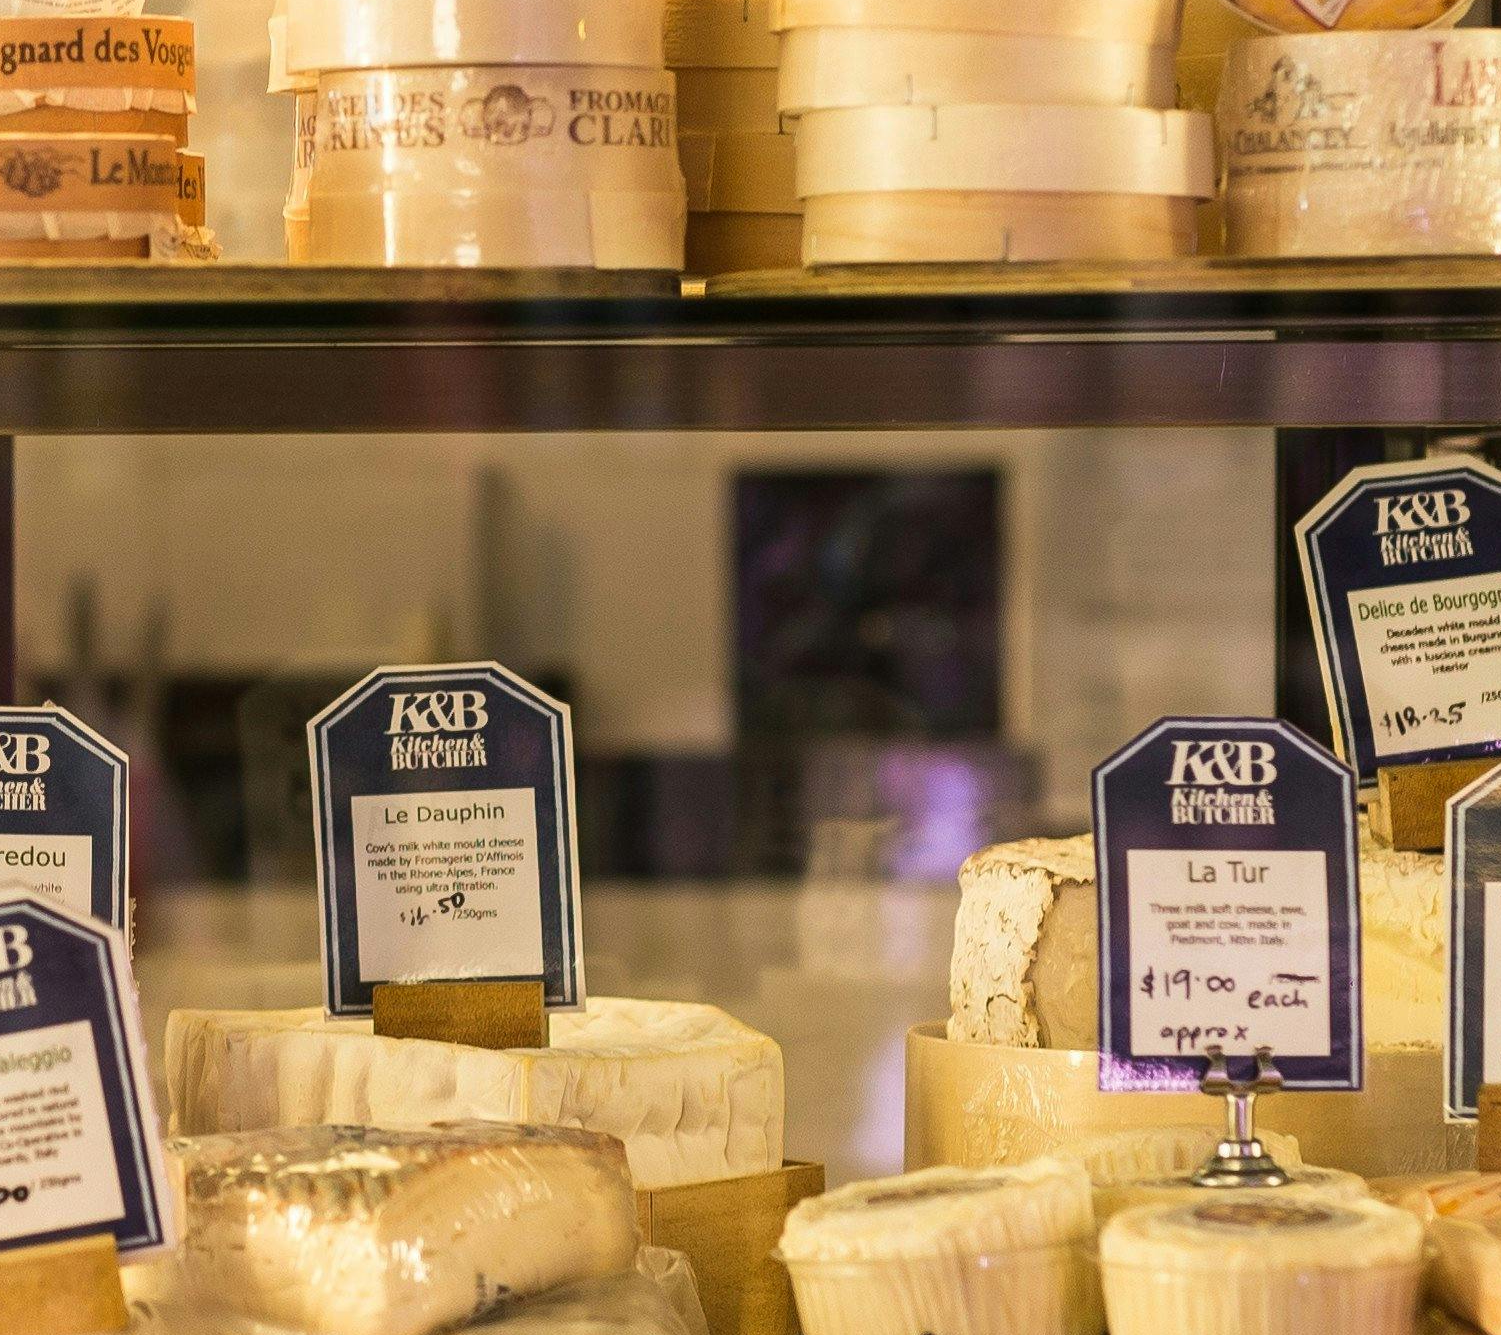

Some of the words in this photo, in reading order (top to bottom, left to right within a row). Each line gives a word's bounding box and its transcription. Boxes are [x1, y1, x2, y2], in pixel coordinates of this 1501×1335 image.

[94, 29, 140, 60] des
[1372, 488, 1472, 536] K&B
[1358, 600, 1406, 622] Delice
[1409, 596, 1429, 614] de
[383, 690, 488, 735] K&B
[1164, 739, 1278, 787] K&B
[385, 807, 408, 825] Le
[417, 803, 506, 826] Dauphin
[1188, 861, 1216, 884] La
[1228, 860, 1270, 884] Tur
[1247, 989, 1309, 1009] each
[1159, 1025, 1249, 1052] approx
